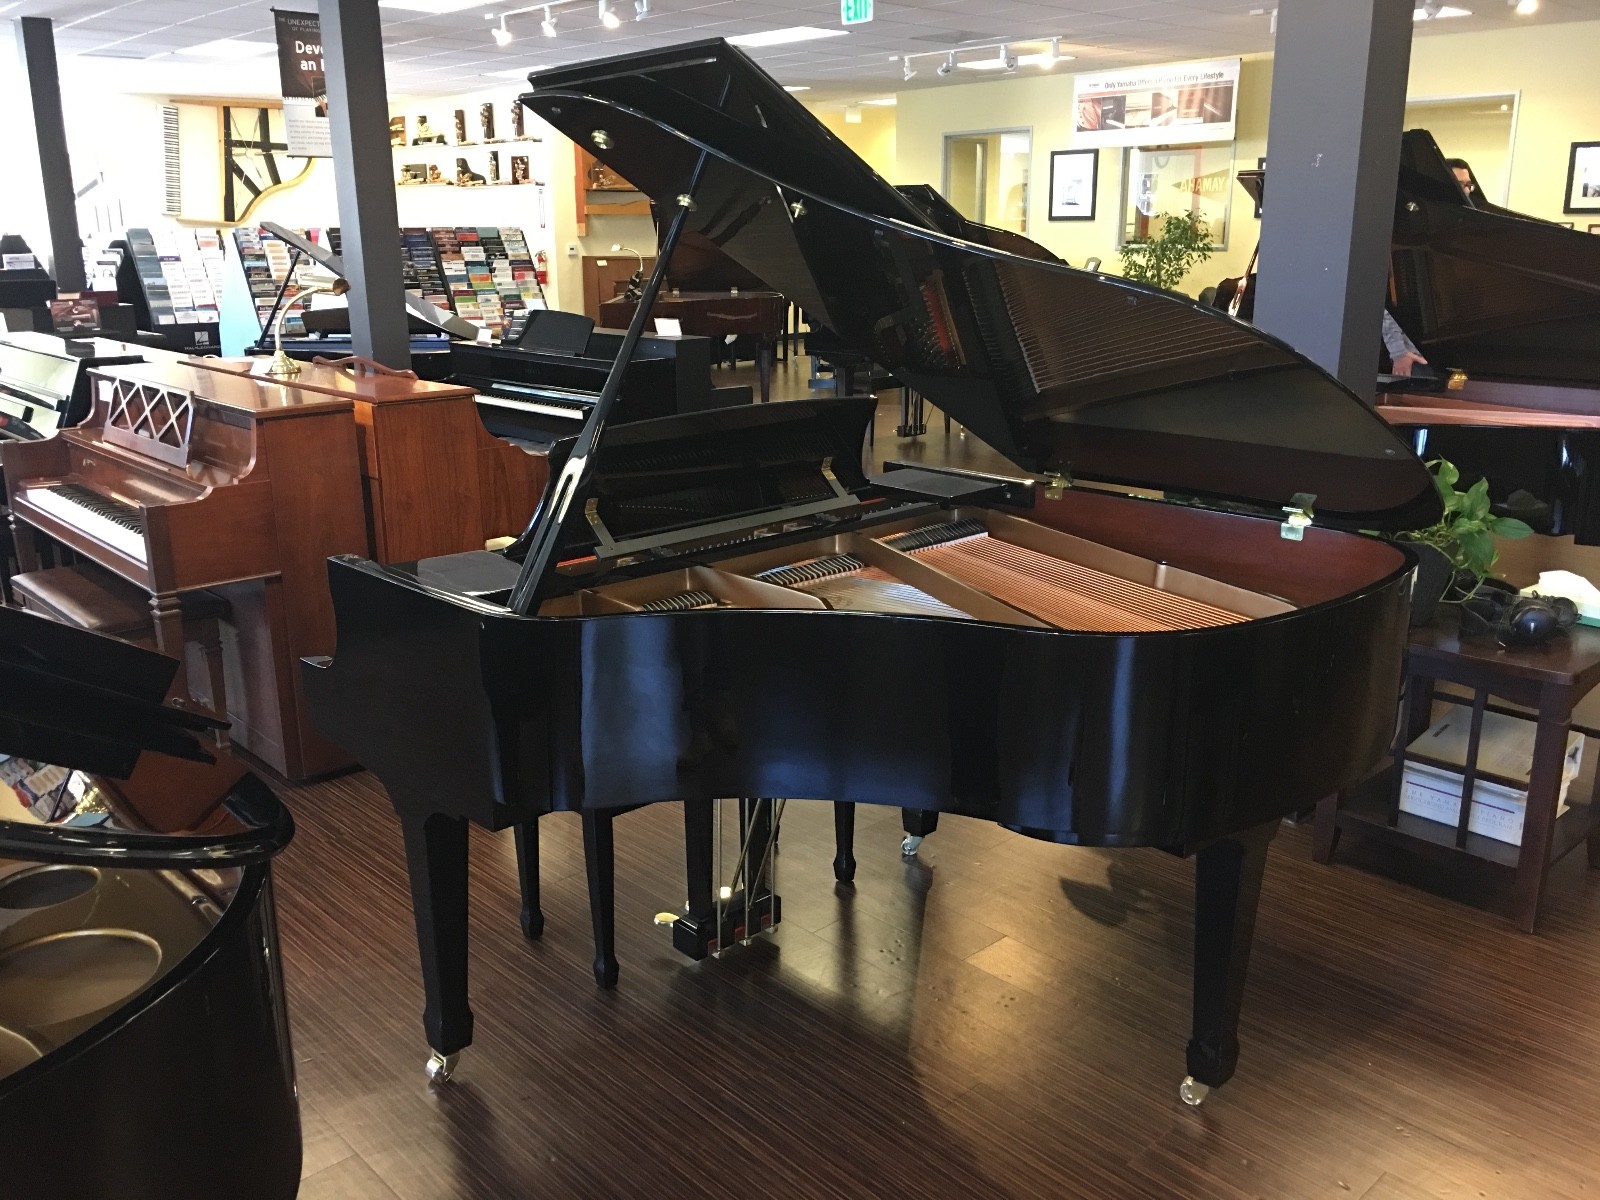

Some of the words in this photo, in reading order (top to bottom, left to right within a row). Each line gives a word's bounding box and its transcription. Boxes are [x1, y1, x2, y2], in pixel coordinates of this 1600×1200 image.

[846, 0, 868, 20] EXIT
[287, 18, 320, 27] UNEXPECT
[300, 60, 317, 71] an
[1104, 81, 1116, 90] Only
[1117, 80, 1136, 88] Yamaha
[1183, 74, 1199, 82] Every
[1200, 71, 1224, 81] Lifestyle
